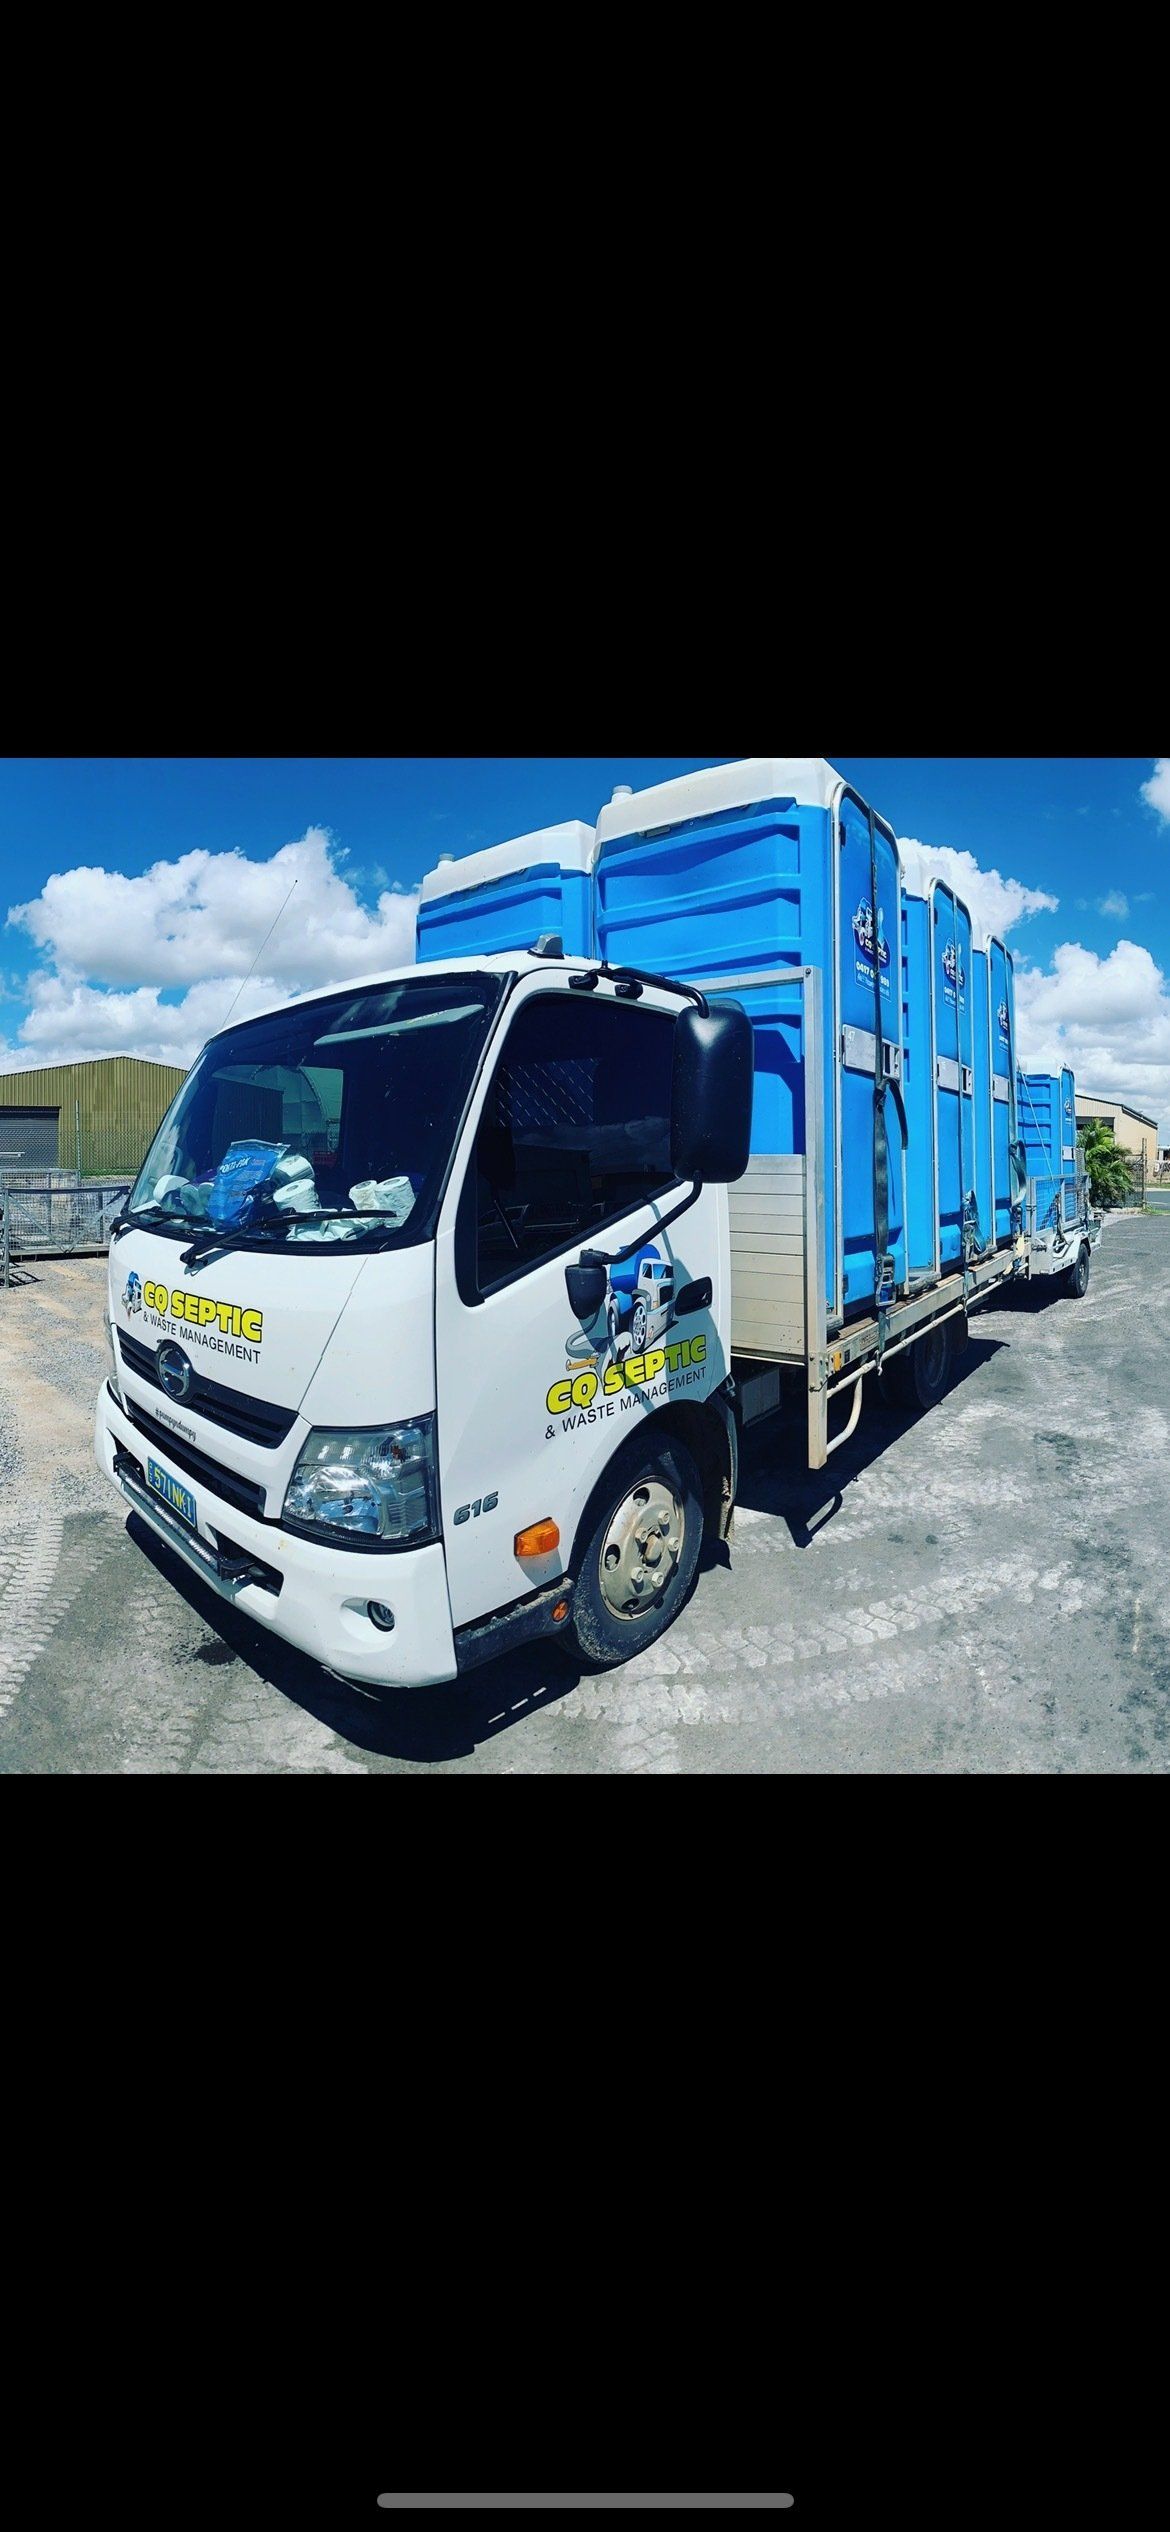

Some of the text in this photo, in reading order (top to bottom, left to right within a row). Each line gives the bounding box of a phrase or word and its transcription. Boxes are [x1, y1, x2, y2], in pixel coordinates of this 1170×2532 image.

[143, 1280, 263, 1344] CQ SEPTIC
[143, 1311, 262, 1364] & WASTE MANAGEMENT
[544, 1366, 706, 1440] & WASTE MANAGEMENT
[546, 1334, 706, 1415] CQ SEPTIC
[453, 1490, 499, 1526] 616
